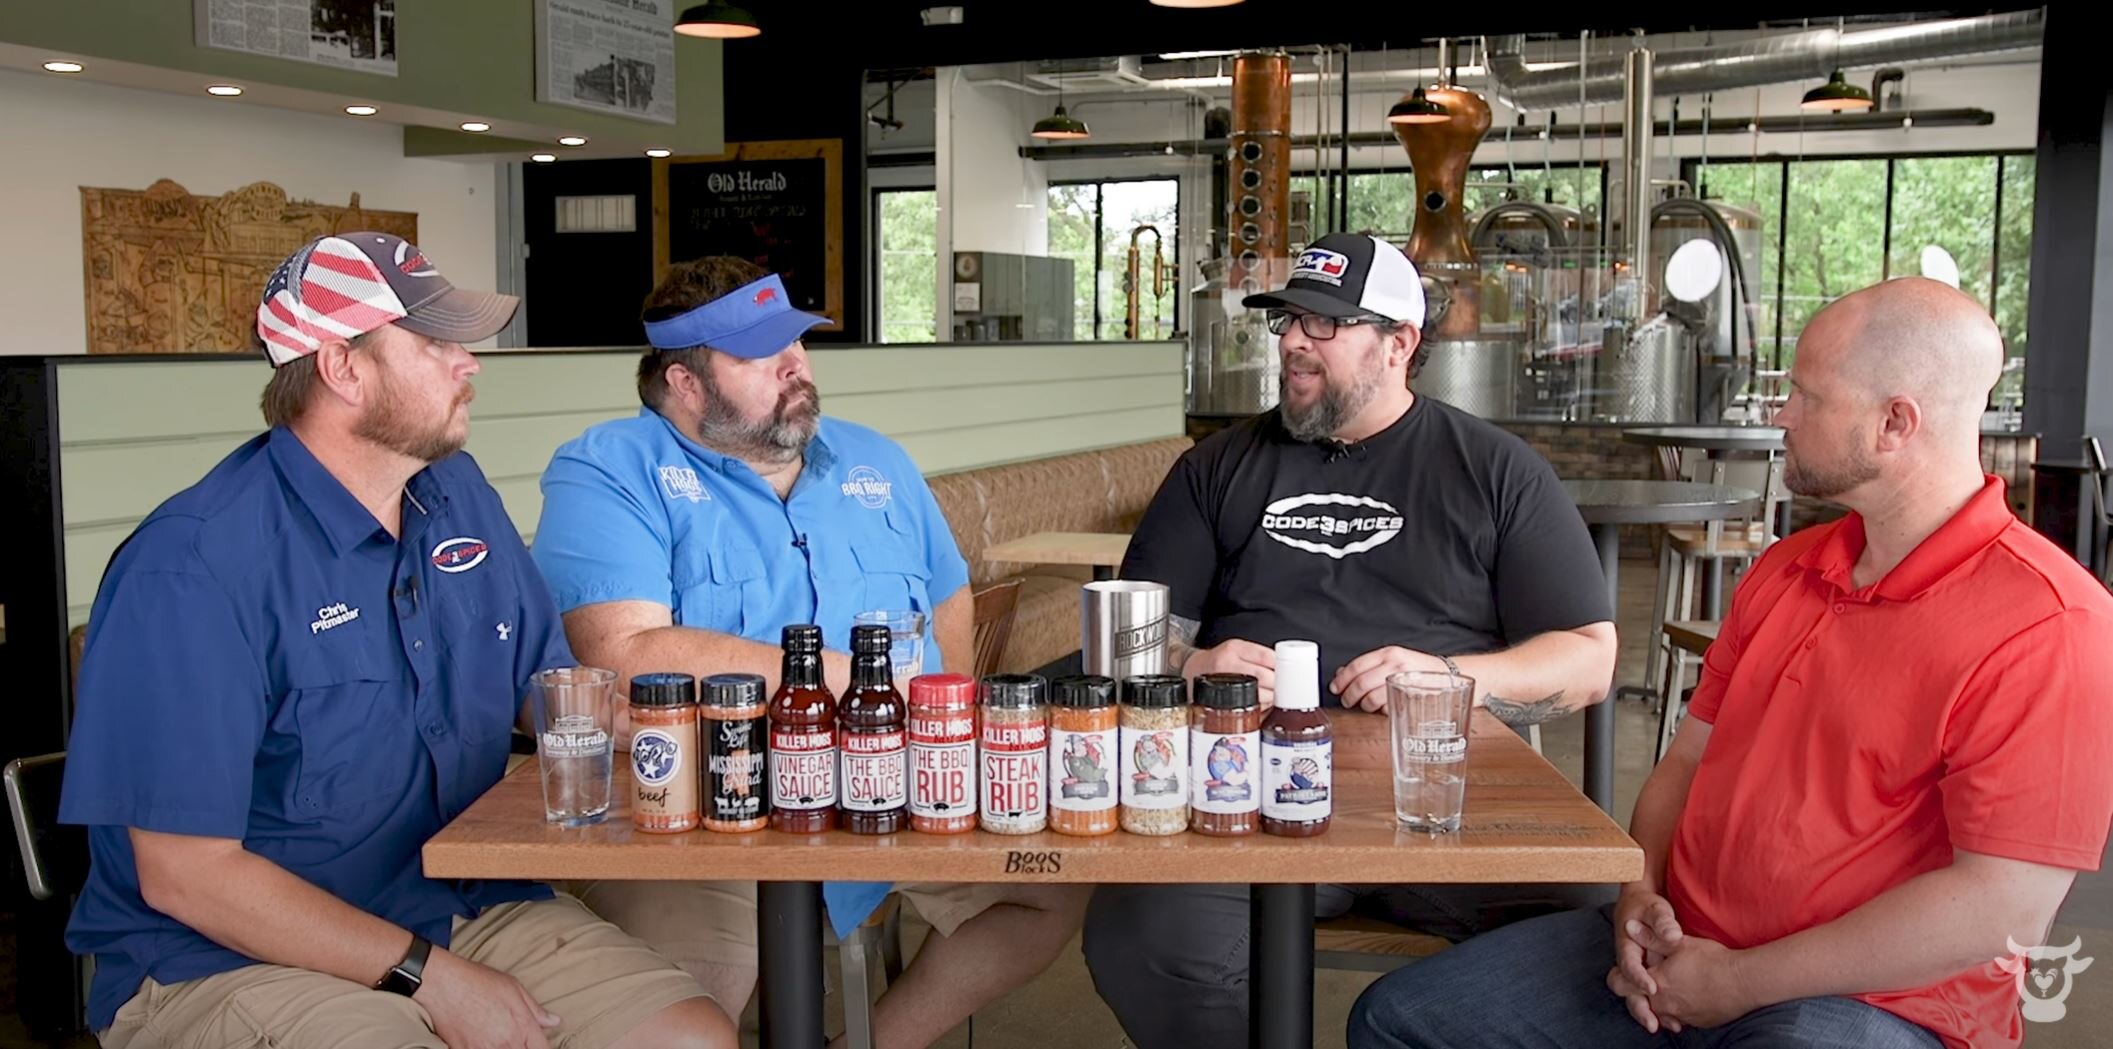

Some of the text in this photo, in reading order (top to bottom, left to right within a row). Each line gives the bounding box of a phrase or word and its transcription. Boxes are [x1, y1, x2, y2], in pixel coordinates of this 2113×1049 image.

[707, 171, 787, 193] Old Herald
[841, 481, 892, 500] BBQ RIGHT
[311, 608, 360, 634] Pitmaster
[318, 602, 348, 620] Chris
[910, 718, 943, 738] KILLER
[945, 717, 974, 736] HOGS
[982, 727, 1019, 745] KILLER
[1021, 725, 1046, 743] HOGS
[543, 730, 607, 748] Old Herald
[776, 732, 832, 749] KILLER HOGS
[848, 734, 904, 752] KILLER HOGS
[1402, 736, 1466, 753] Old Herald
[709, 752, 763, 774] MISSISSIPPI
[776, 754, 833, 774] VINEGAR
[848, 755, 903, 777] THE BBQ
[912, 748, 968, 769] THE BBQ
[986, 755, 1041, 782] STEAK
[780, 773, 831, 798] SAUCE
[852, 773, 902, 799] SAUCE
[917, 769, 965, 804] RUB
[638, 787, 671, 808] beef
[990, 781, 1039, 813] RUB
